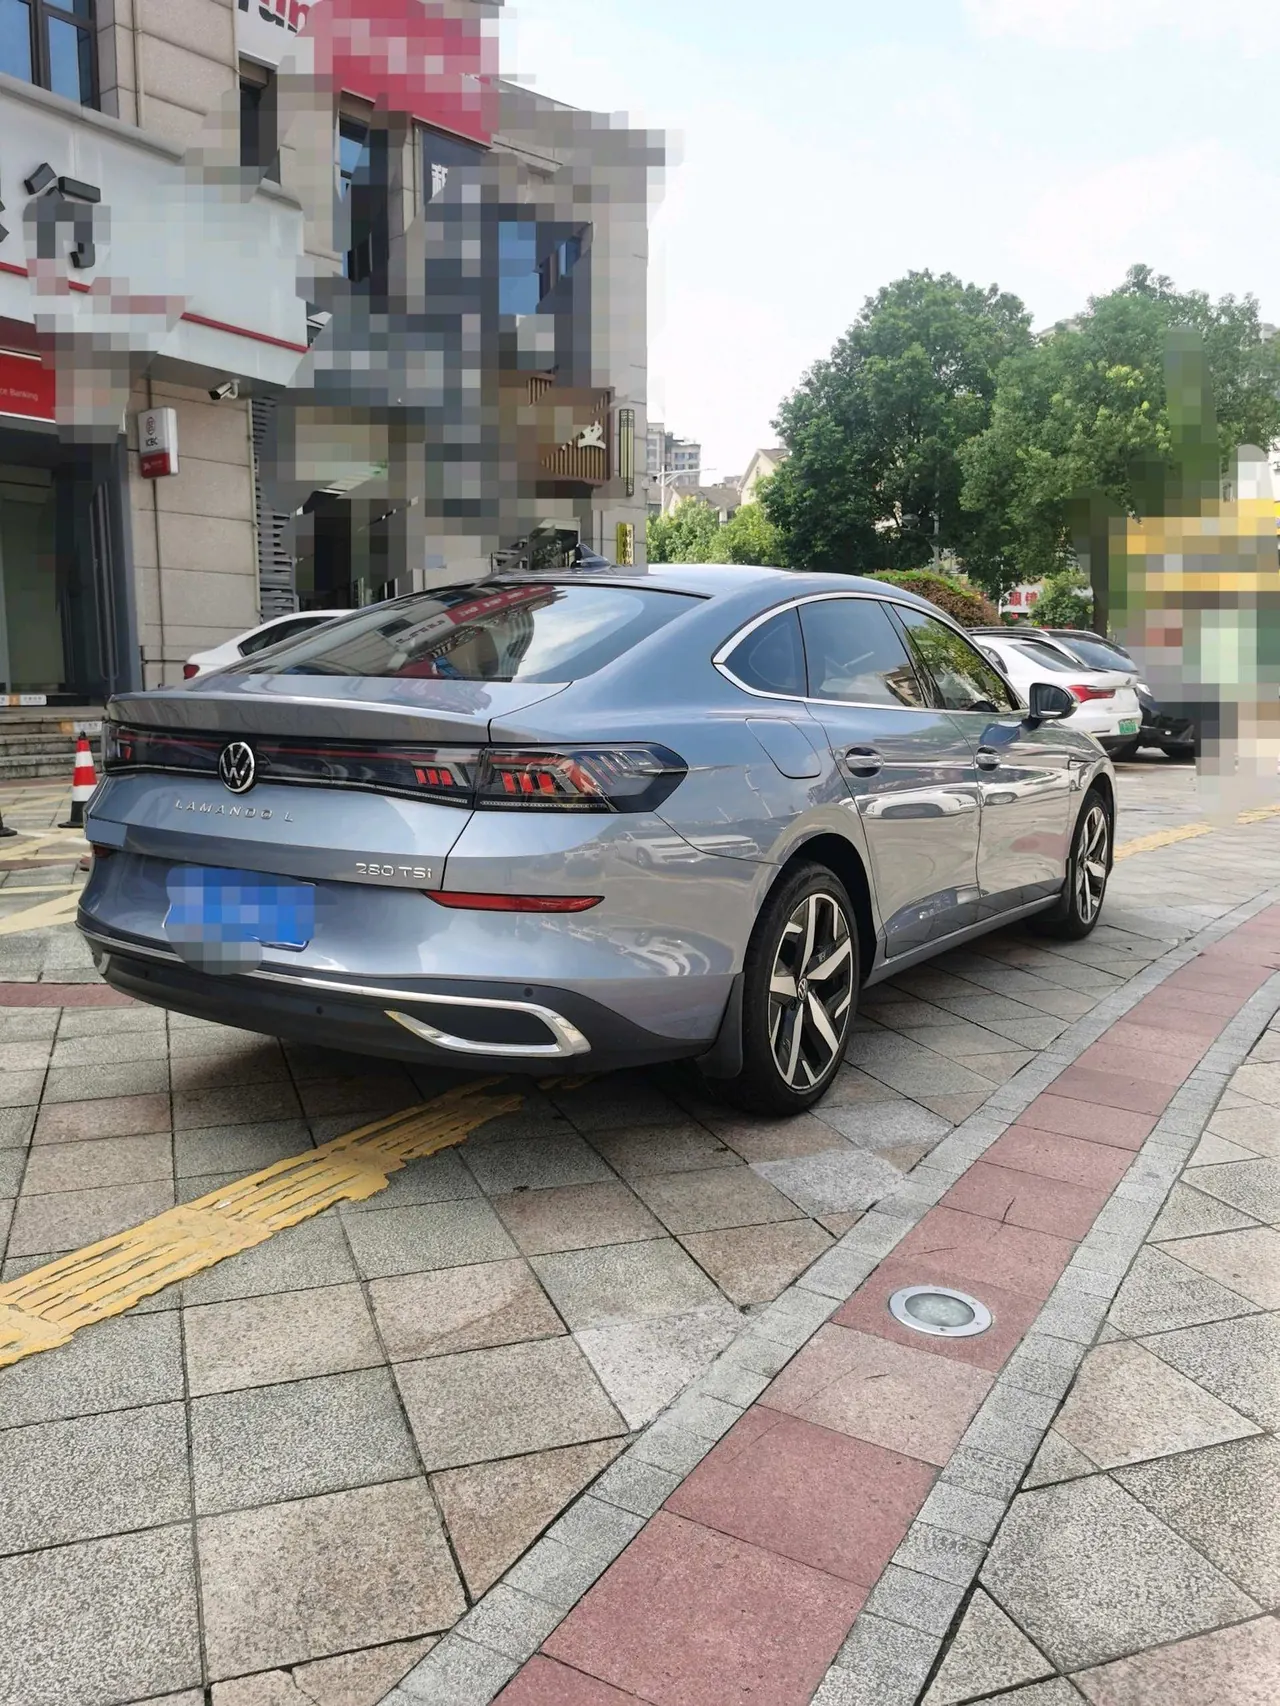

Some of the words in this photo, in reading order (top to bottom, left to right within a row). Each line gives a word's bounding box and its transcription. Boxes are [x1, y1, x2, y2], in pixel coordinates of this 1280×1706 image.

[10, 388, 38, 401] Banking
[175, 800, 273, 820] LAMANDO
[284, 811, 294, 822] L
[355, 862, 395, 877] 280
